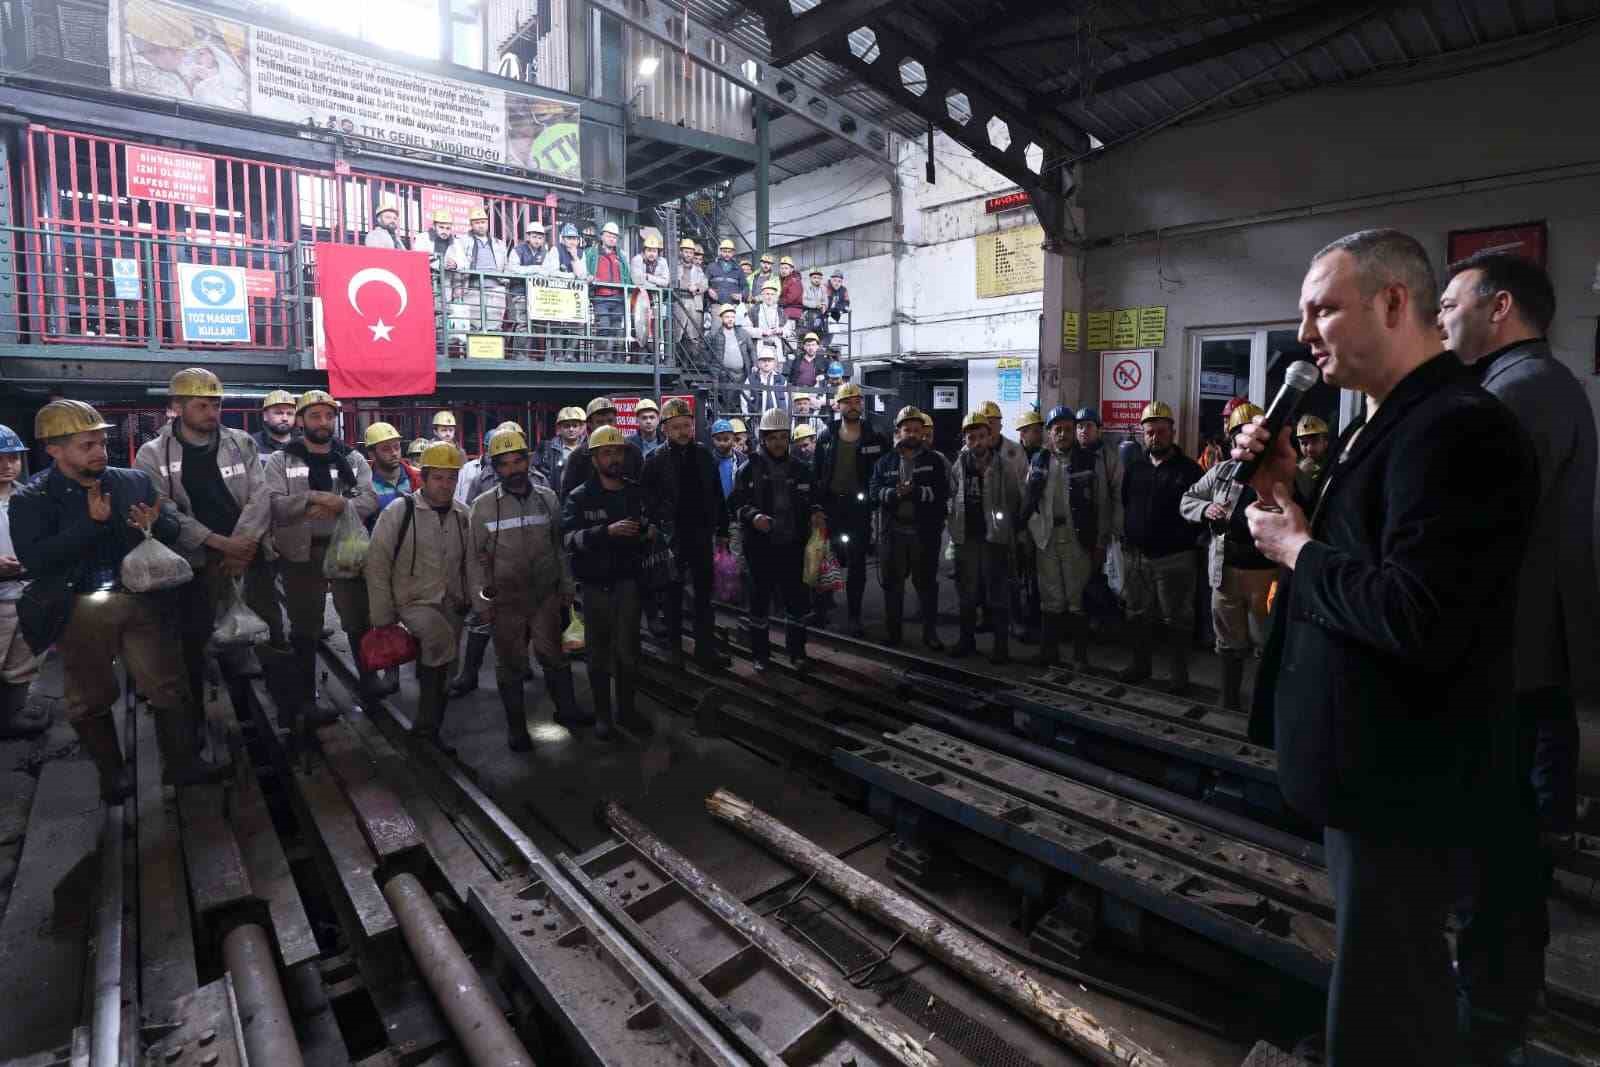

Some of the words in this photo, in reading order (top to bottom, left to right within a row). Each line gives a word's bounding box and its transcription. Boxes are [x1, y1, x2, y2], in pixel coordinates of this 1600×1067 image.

[360, 125, 385, 138] TTK
[388, 130, 425, 146] GENEL
[432, 138, 499, 160] MÜDÜRLÜĞÜ
[188, 312, 206, 322] TOZ
